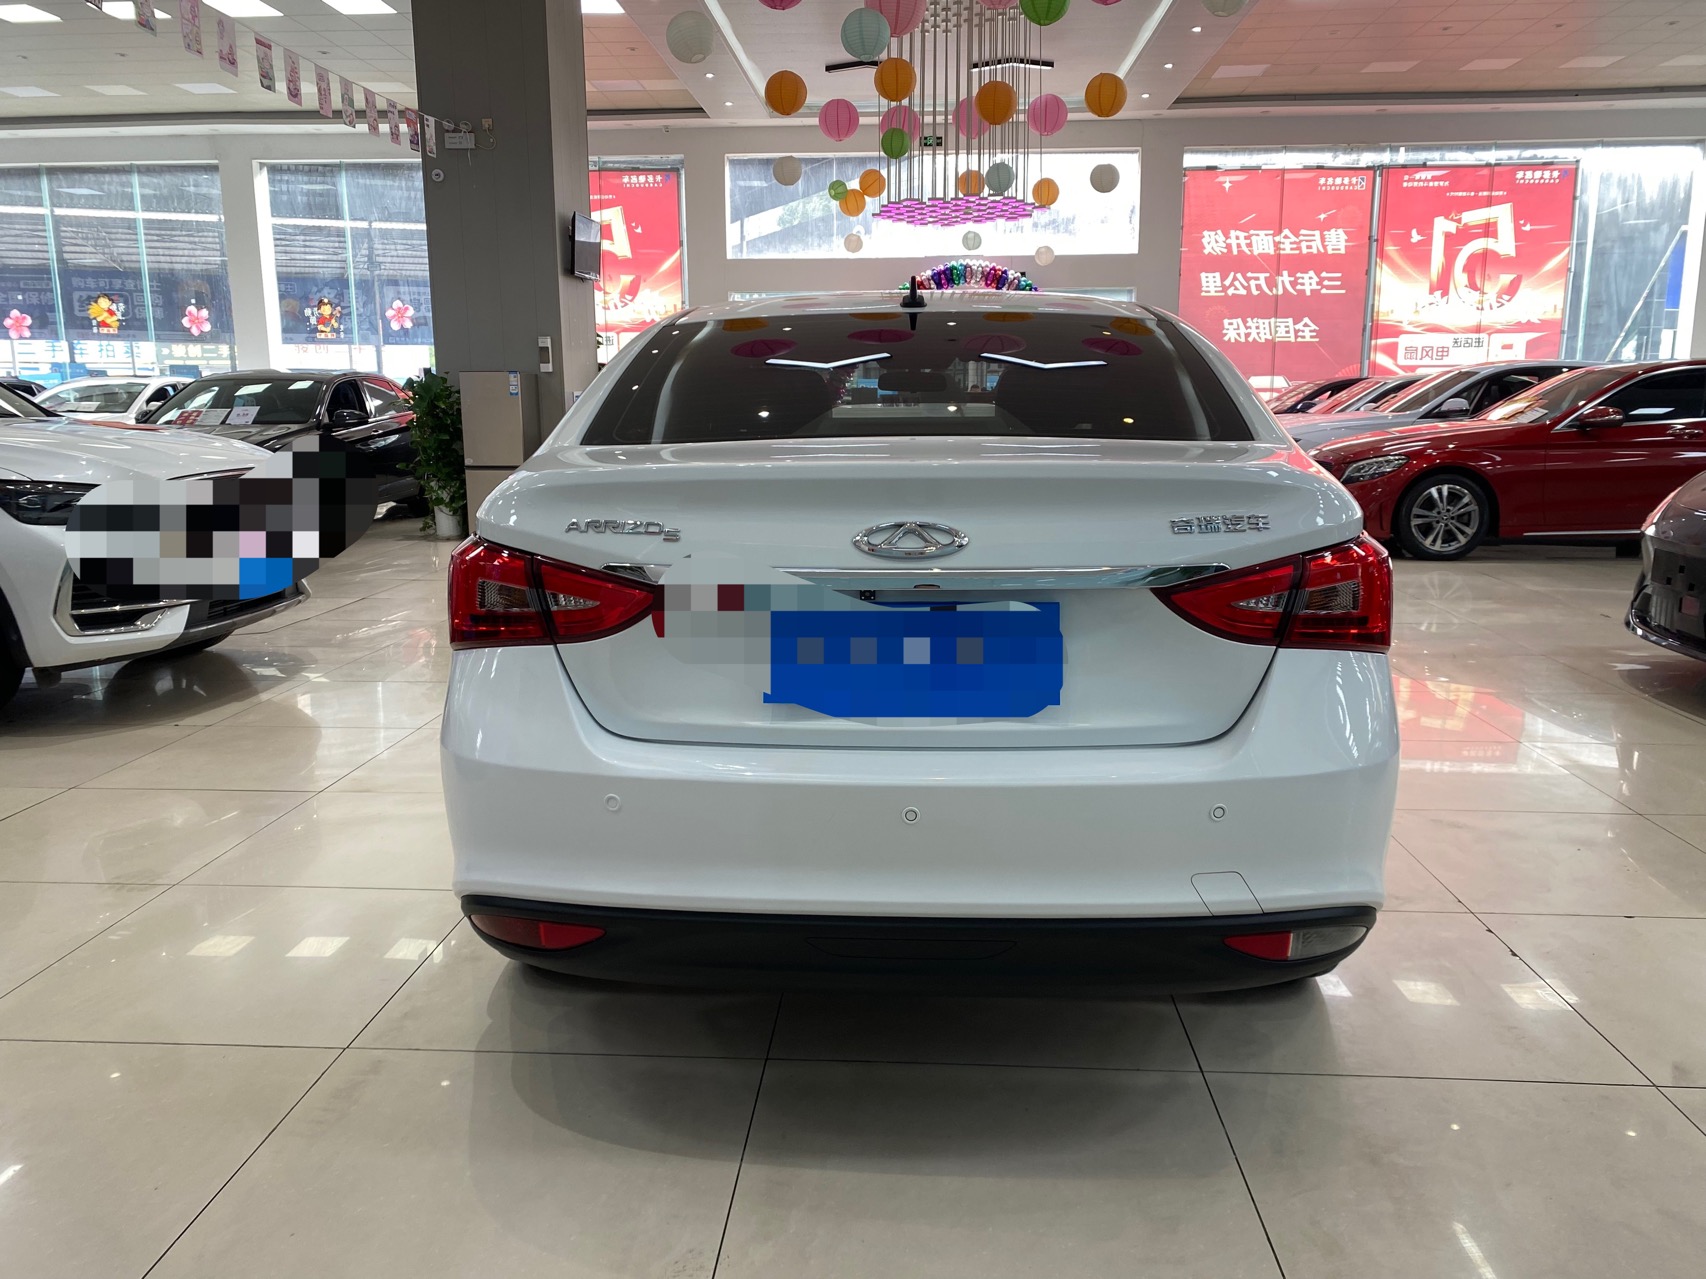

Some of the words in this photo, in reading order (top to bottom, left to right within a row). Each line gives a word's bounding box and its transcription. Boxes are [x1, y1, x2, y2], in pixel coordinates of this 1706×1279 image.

[17, 340, 142, 359] 二手车拍卖
[1169, 514, 1272, 534] 奇瑞汽车
